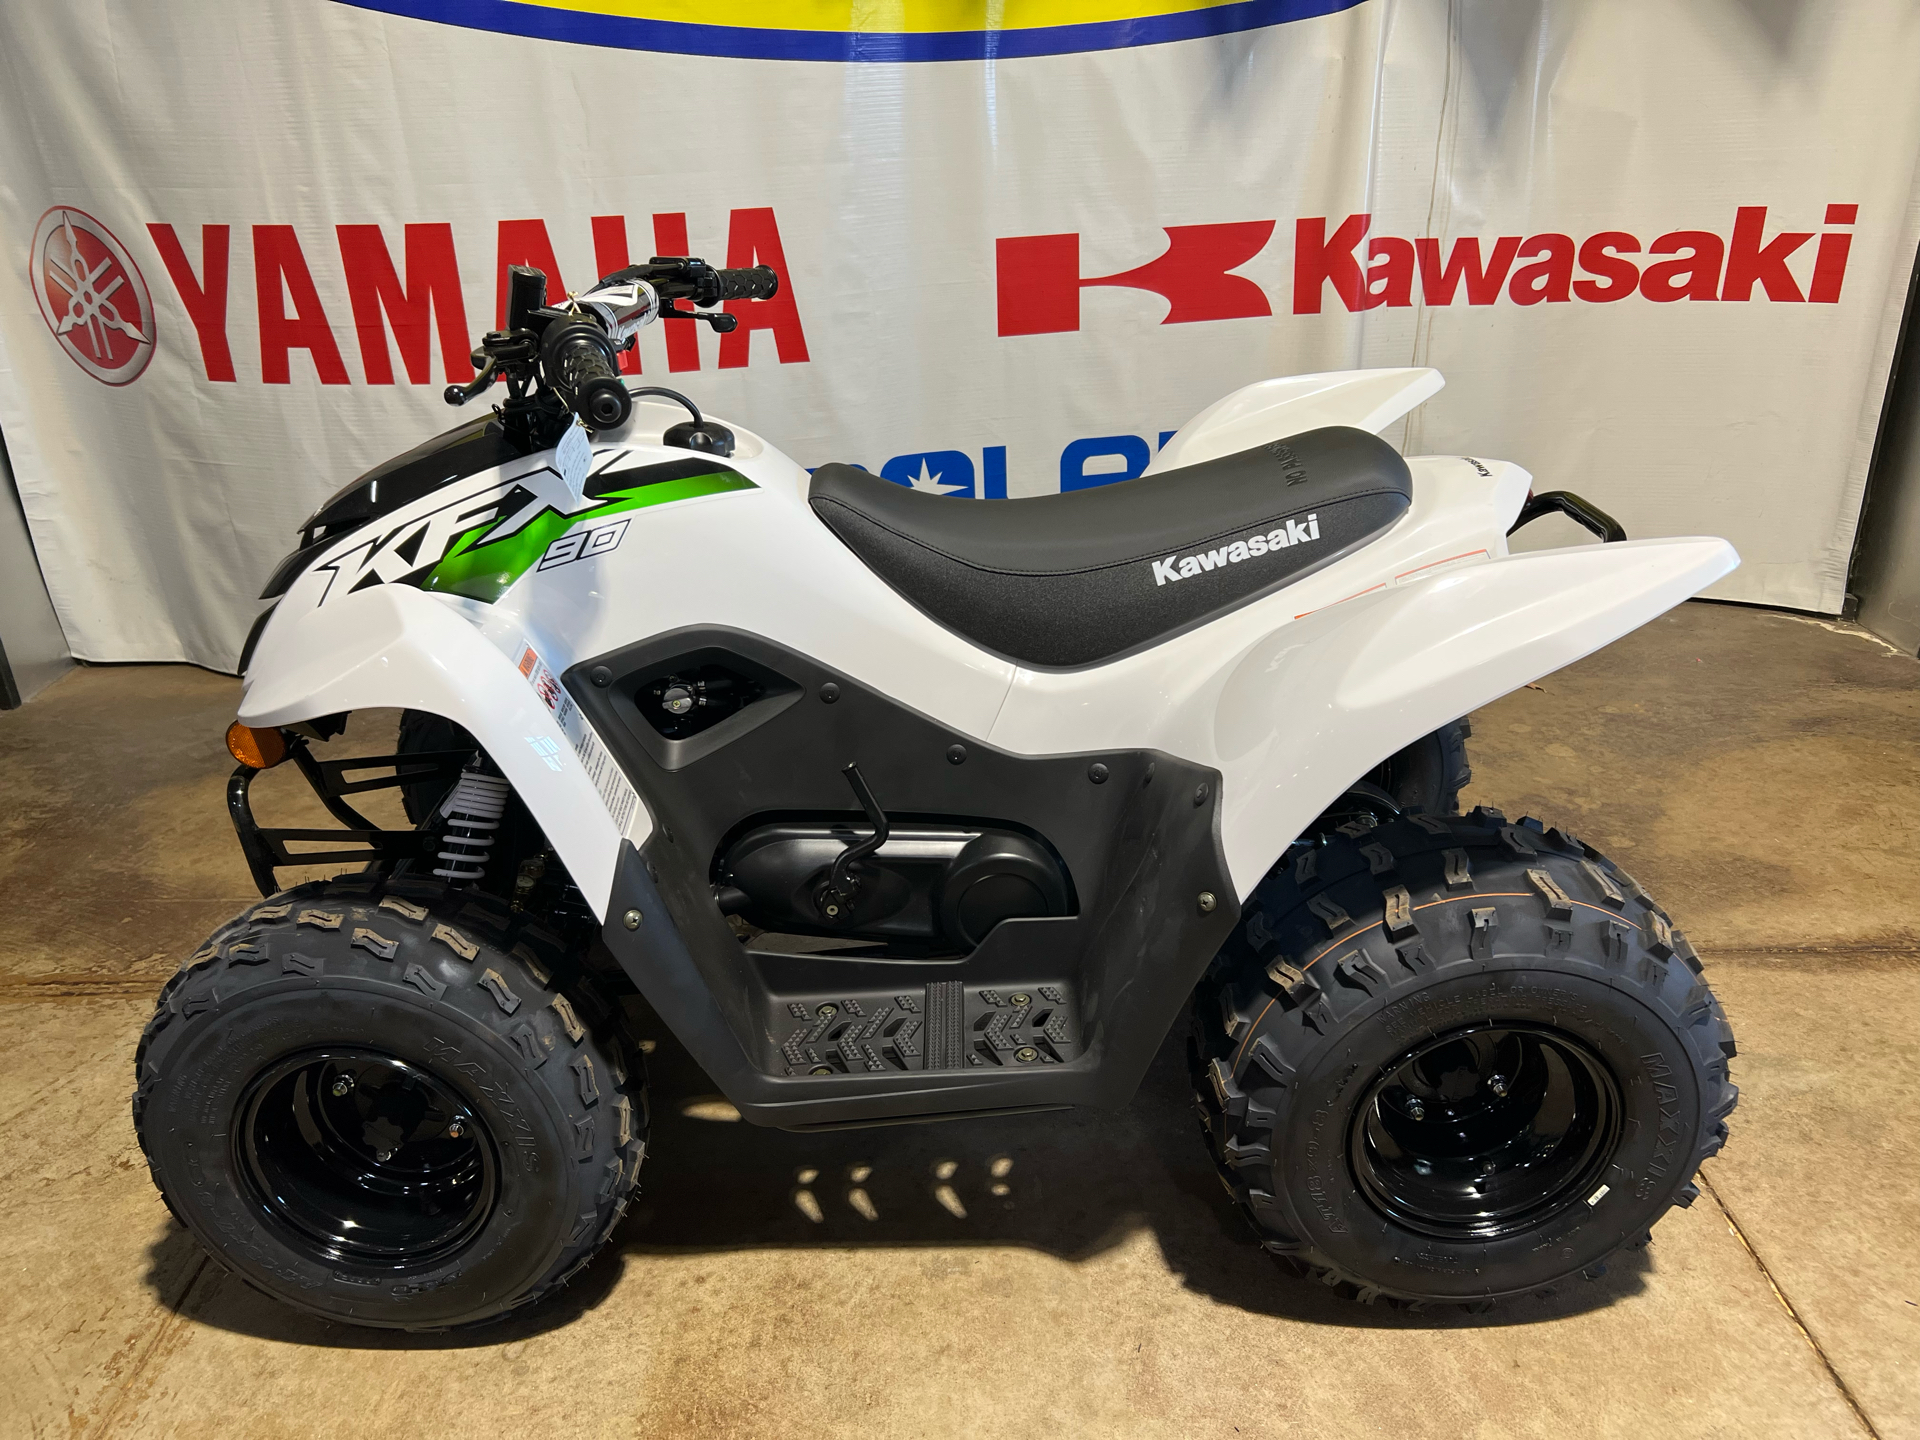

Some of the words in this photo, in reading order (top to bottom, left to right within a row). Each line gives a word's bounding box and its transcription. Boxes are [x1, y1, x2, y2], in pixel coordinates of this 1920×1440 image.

[1292, 203, 1859, 315] Kawasaki
[312, 450, 634, 608] KFX
[536, 517, 633, 573] 90
[1151, 513, 1321, 587] Kawasaki
[1635, 1052, 1681, 1200] MAXXIS
